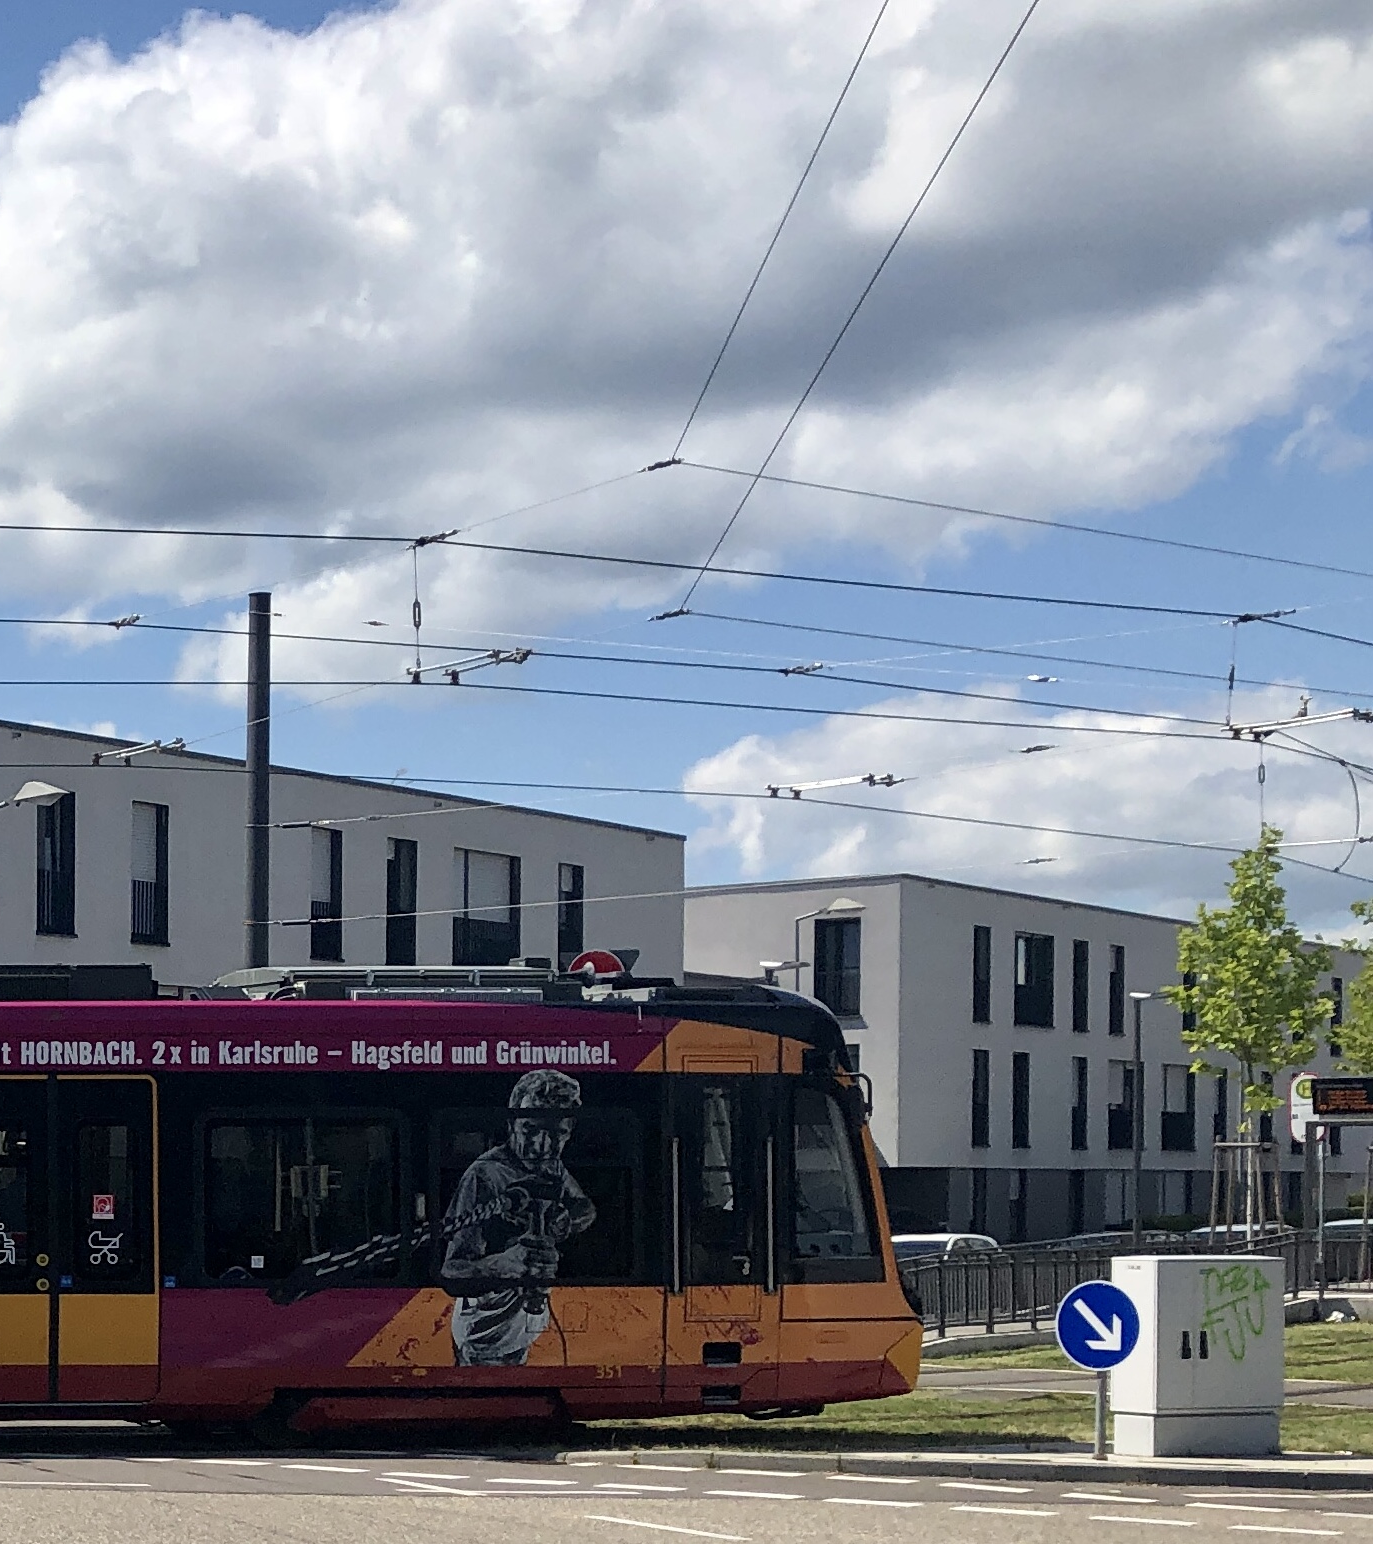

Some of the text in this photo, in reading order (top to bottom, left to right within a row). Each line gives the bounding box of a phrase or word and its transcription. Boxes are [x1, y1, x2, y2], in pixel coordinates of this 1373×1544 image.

[20, 1040, 143, 1066] HORNBACH.
[190, 1039, 210, 1065] in
[218, 1040, 319, 1065] Karlsruhe
[351, 1040, 443, 1070] Hagsfeld
[451, 1040, 488, 1065] und
[496, 1040, 617, 1065] Grünwinkel.
[594, 1364, 622, 1379] 351
